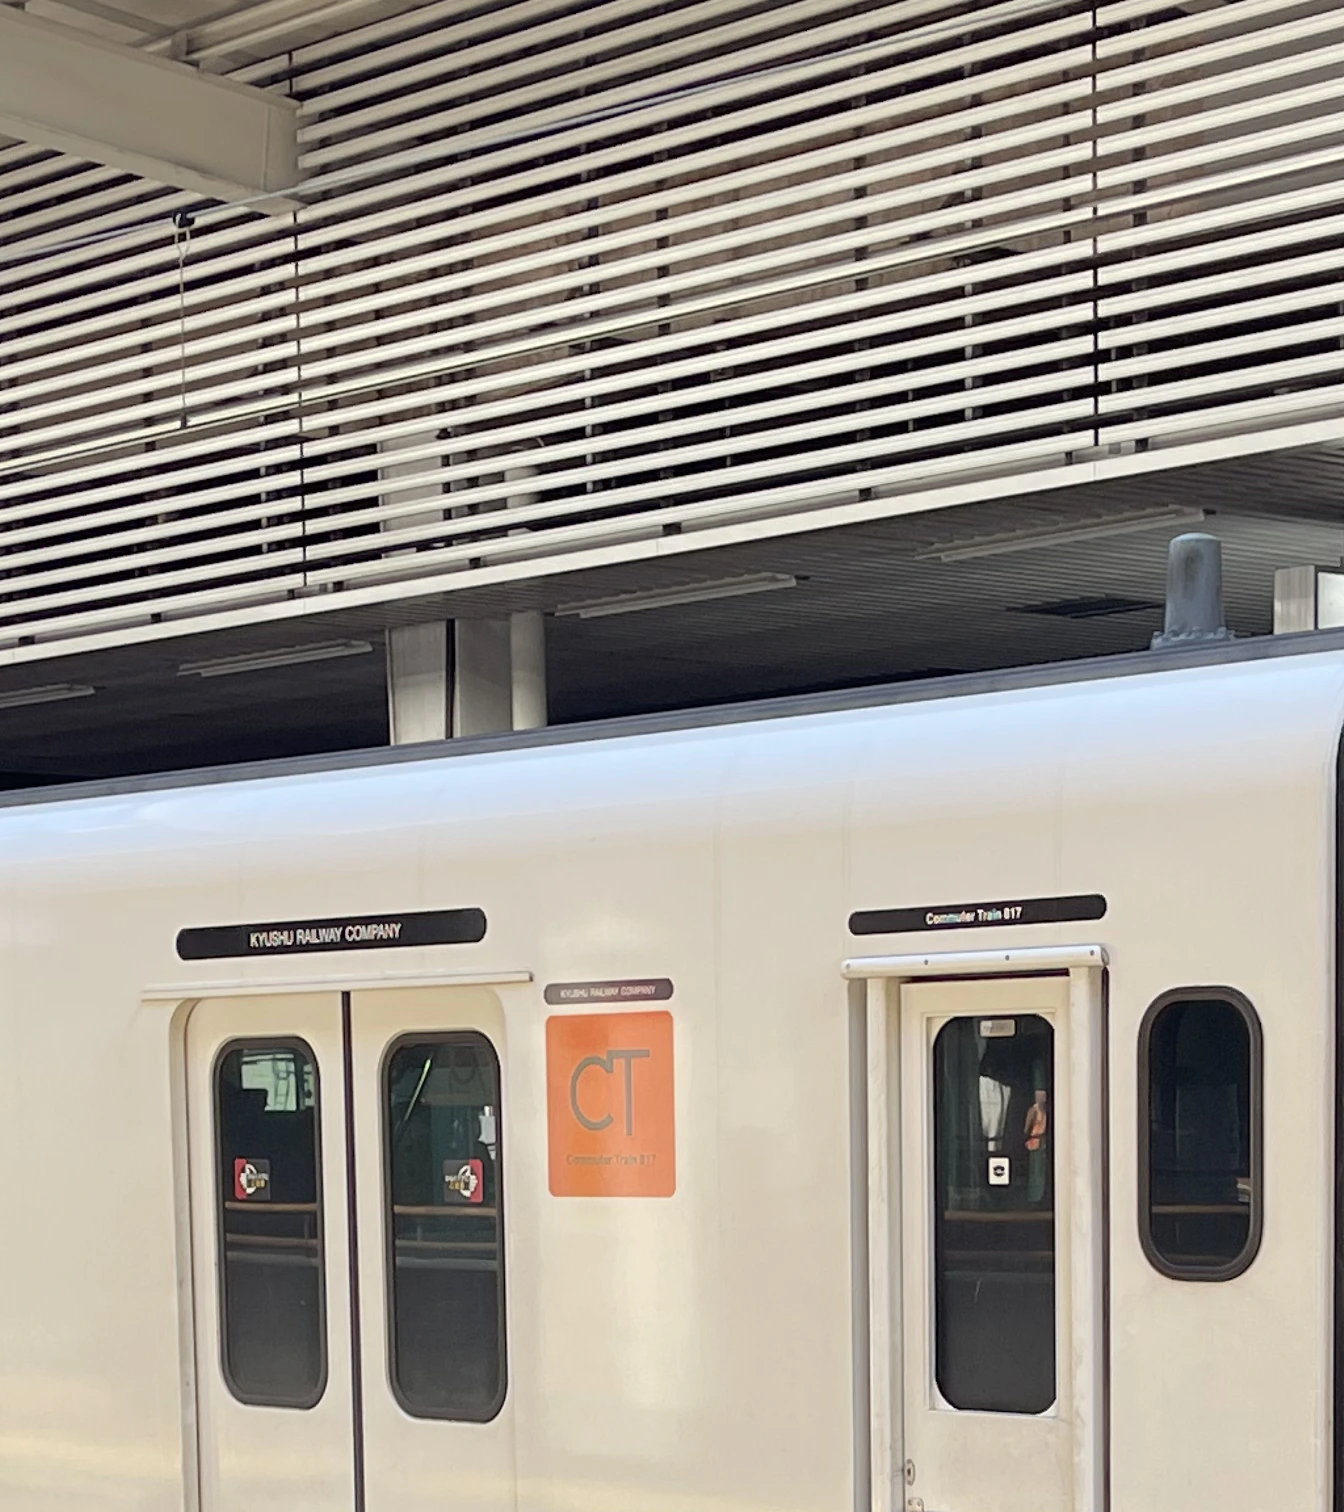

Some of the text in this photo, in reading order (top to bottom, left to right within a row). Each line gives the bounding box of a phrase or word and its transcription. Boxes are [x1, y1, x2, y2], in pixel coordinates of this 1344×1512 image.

[925, 910, 976, 925] Commuter
[977, 908, 1002, 922] Train
[250, 922, 402, 947] KYUSHU RAILWAY COMPANY
[570, 1049, 651, 1136] CT
